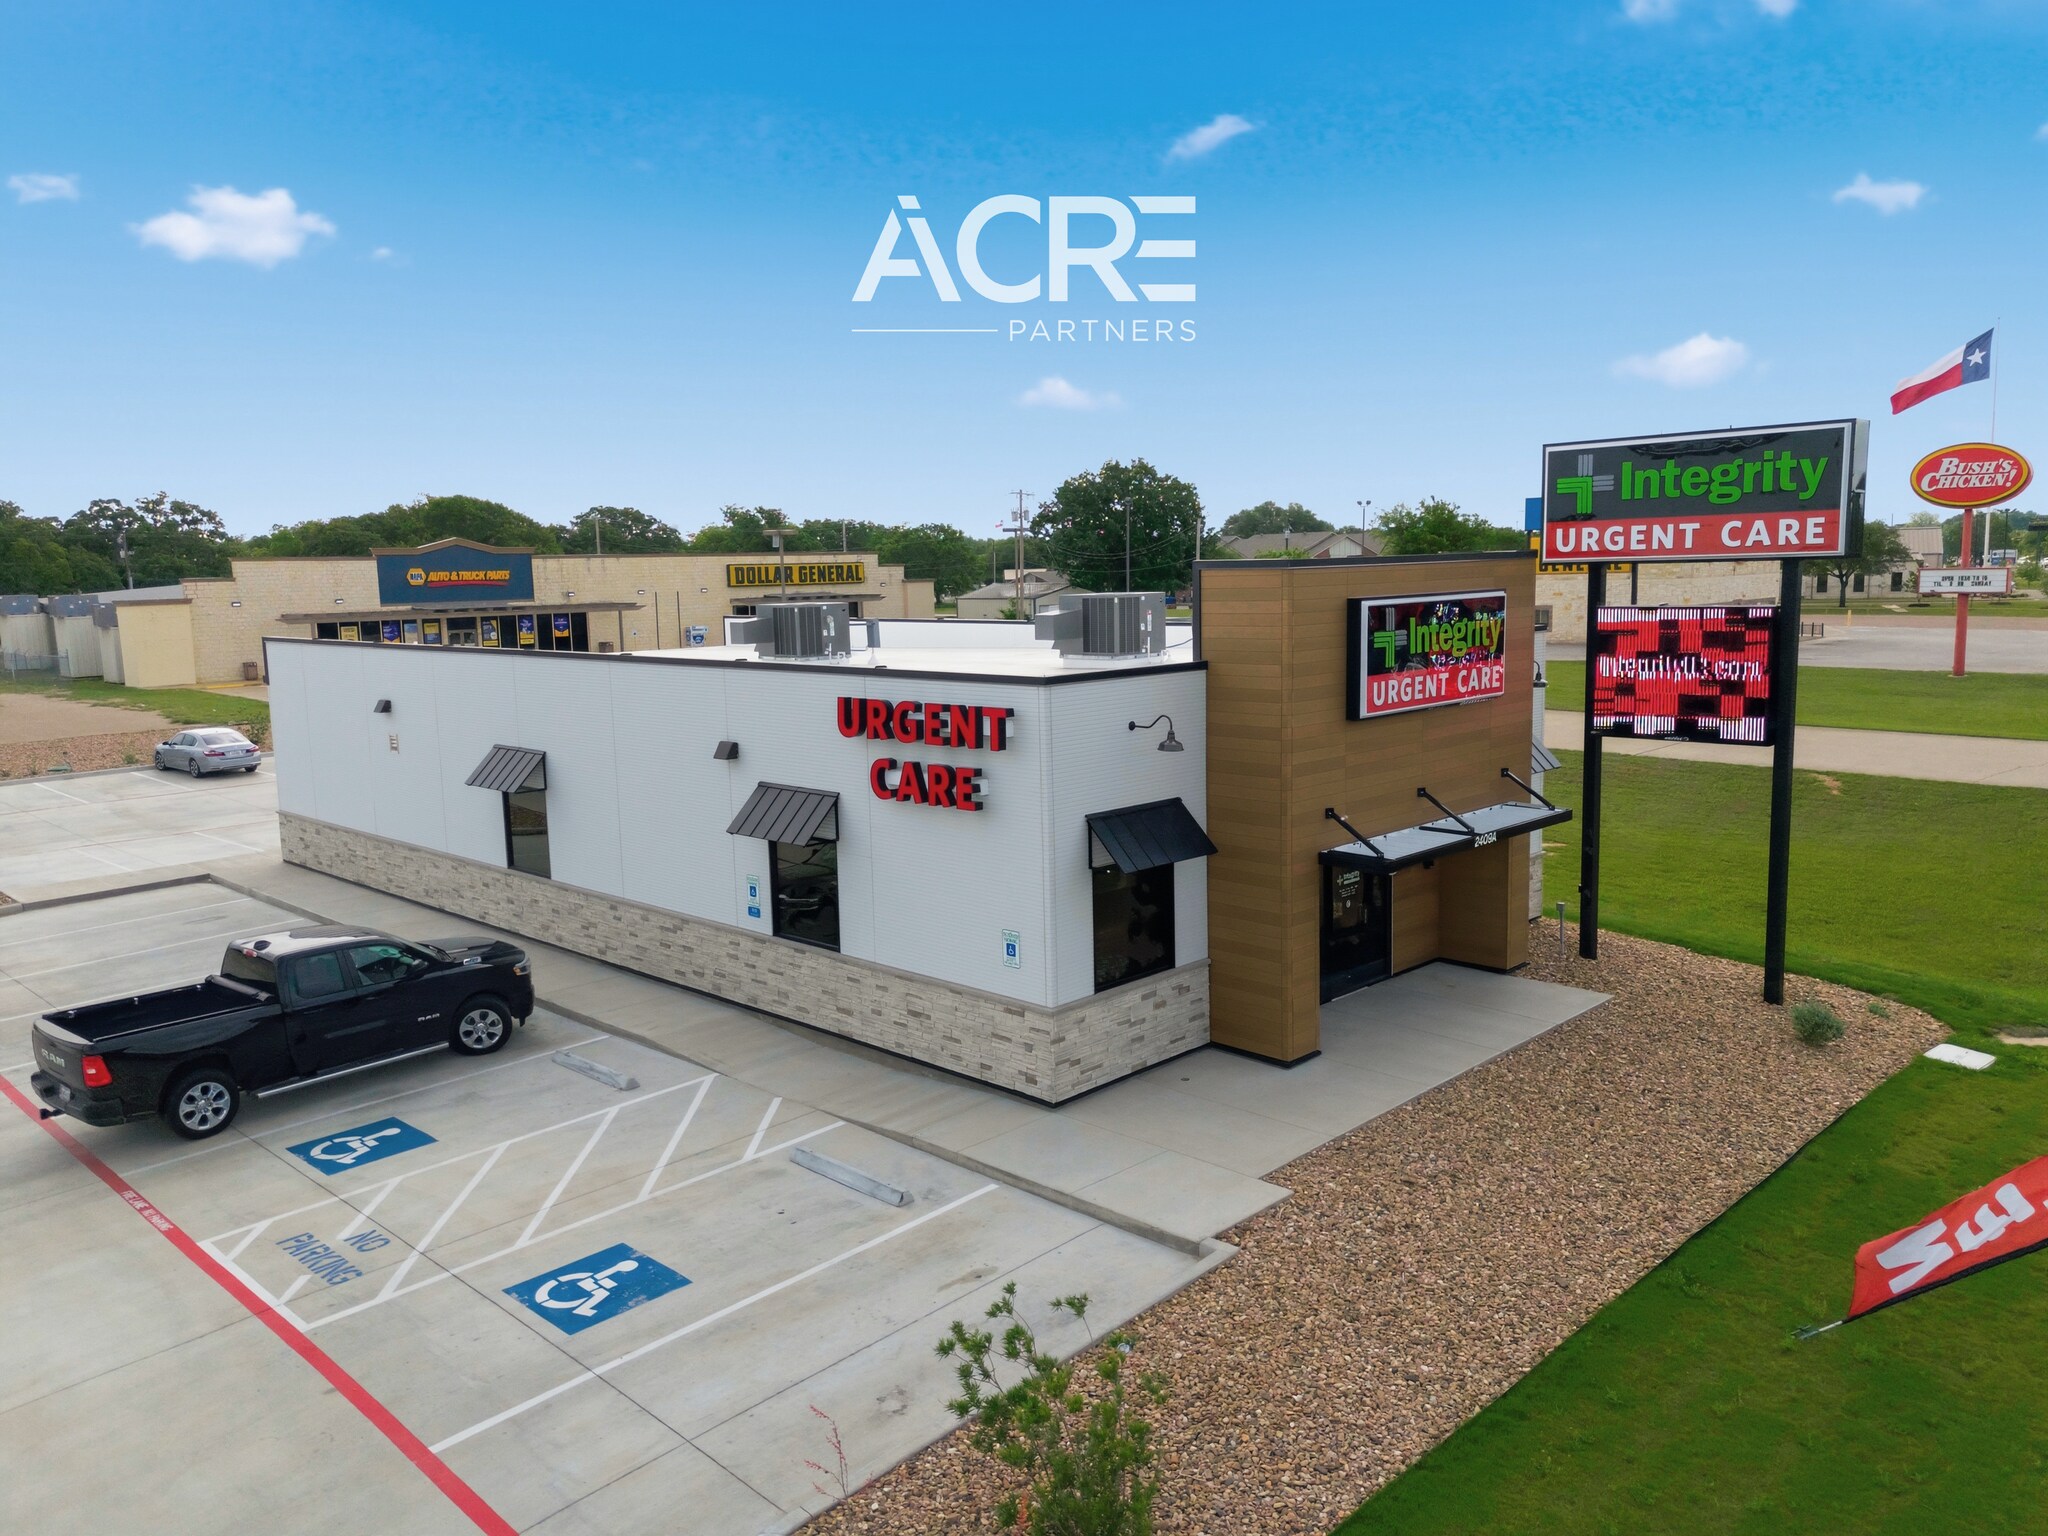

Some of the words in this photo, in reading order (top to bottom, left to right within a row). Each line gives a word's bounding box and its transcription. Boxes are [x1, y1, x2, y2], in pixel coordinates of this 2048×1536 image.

[1621, 451, 1828, 504] Integrity
[1556, 523, 1700, 553] URGENT
[1721, 517, 1826, 548] CARE
[427, 571, 450, 581] AUTO
[459, 571, 486, 580] TRUCK
[487, 570, 510, 580] PARTS
[735, 566, 794, 585] DOLLAR
[799, 562, 862, 583] GENERAL
[1410, 615, 1501, 657] Integrity
[1373, 673, 1449, 706] URGENT
[1457, 666, 1501, 693] CARE
[837, 697, 1013, 751] URGENT
[870, 757, 982, 811] CARE
[417, 1013, 440, 1022] RAM
[41, 1048, 65, 1068] RAM
[275, 1232, 363, 1285] PARKING
[343, 1229, 391, 1252] NO
